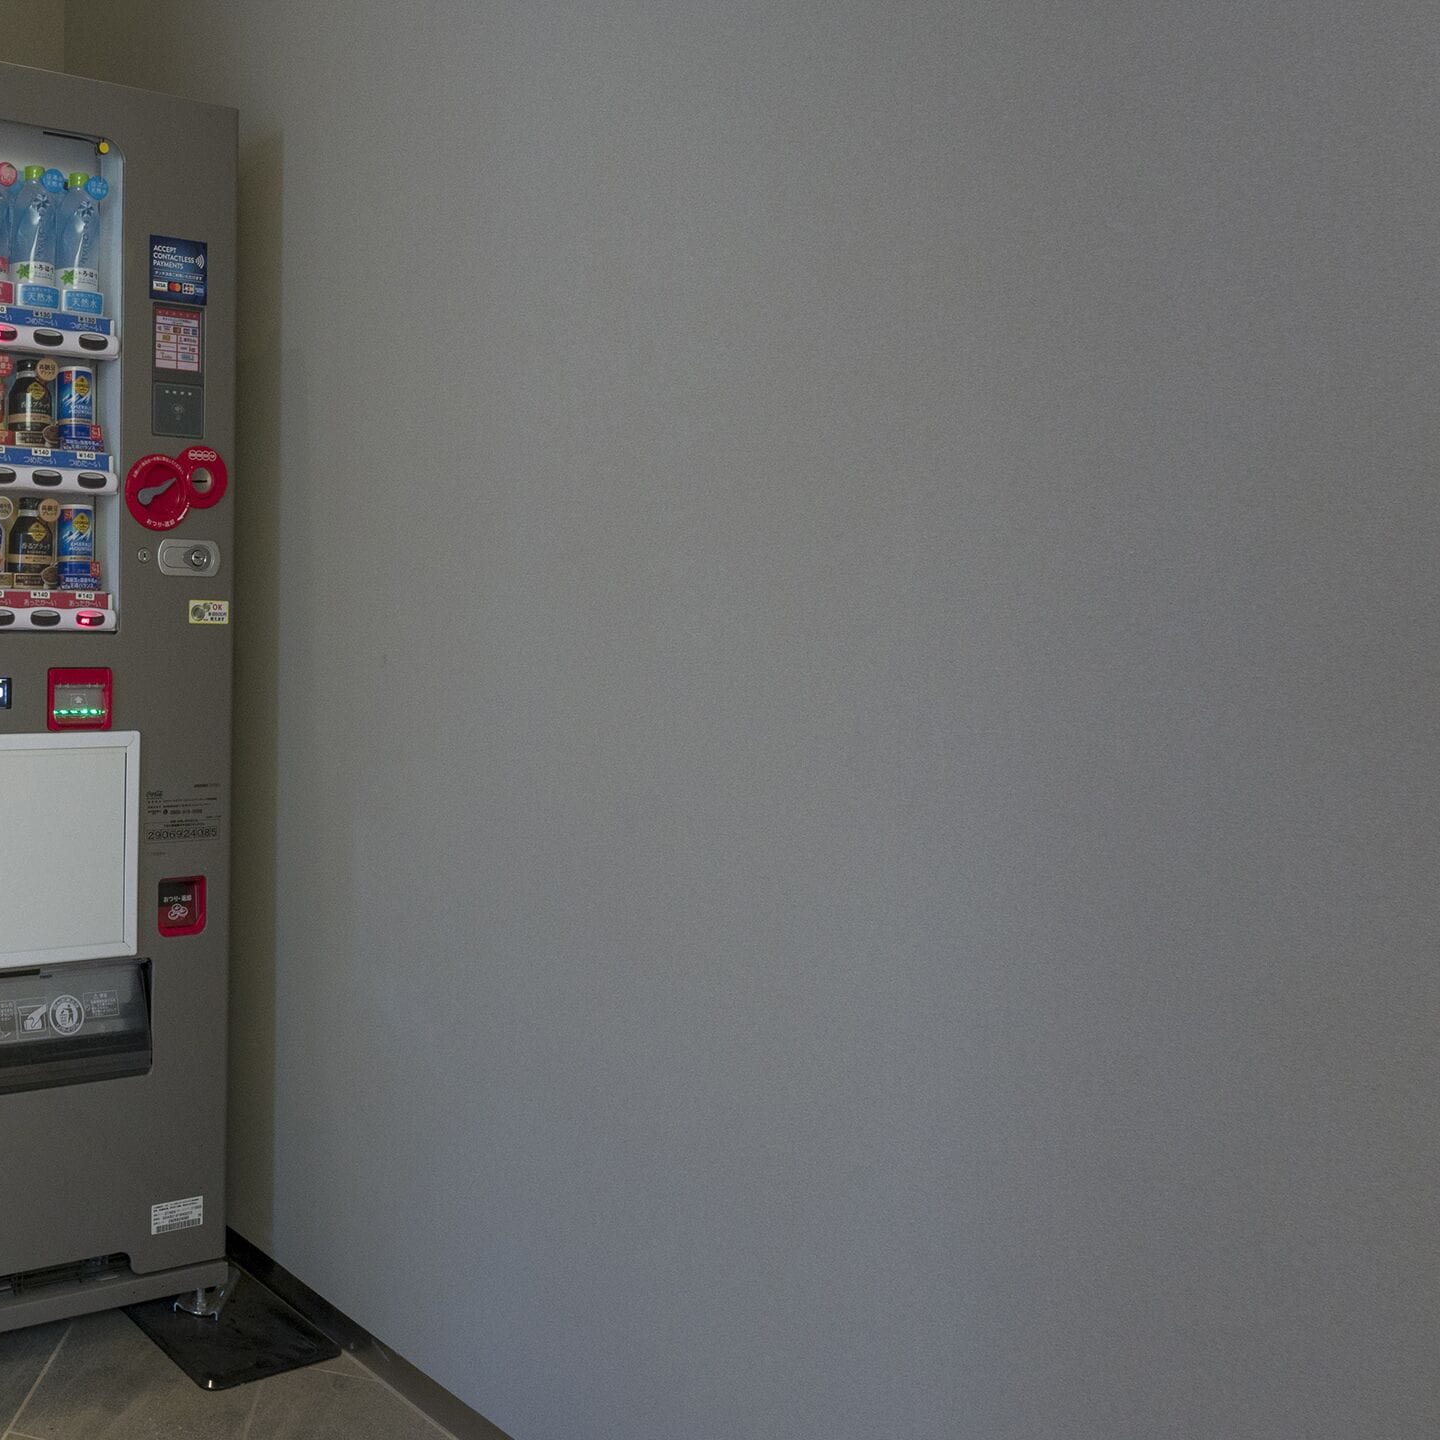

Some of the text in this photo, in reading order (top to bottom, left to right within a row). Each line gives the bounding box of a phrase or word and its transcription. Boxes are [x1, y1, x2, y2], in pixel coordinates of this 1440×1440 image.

[153, 245, 177, 253] ACCEPT
[153, 252, 195, 264] CONTACTLESS
[153, 260, 184, 270] PAYMENTS
[212, 603, 223, 611] OK
